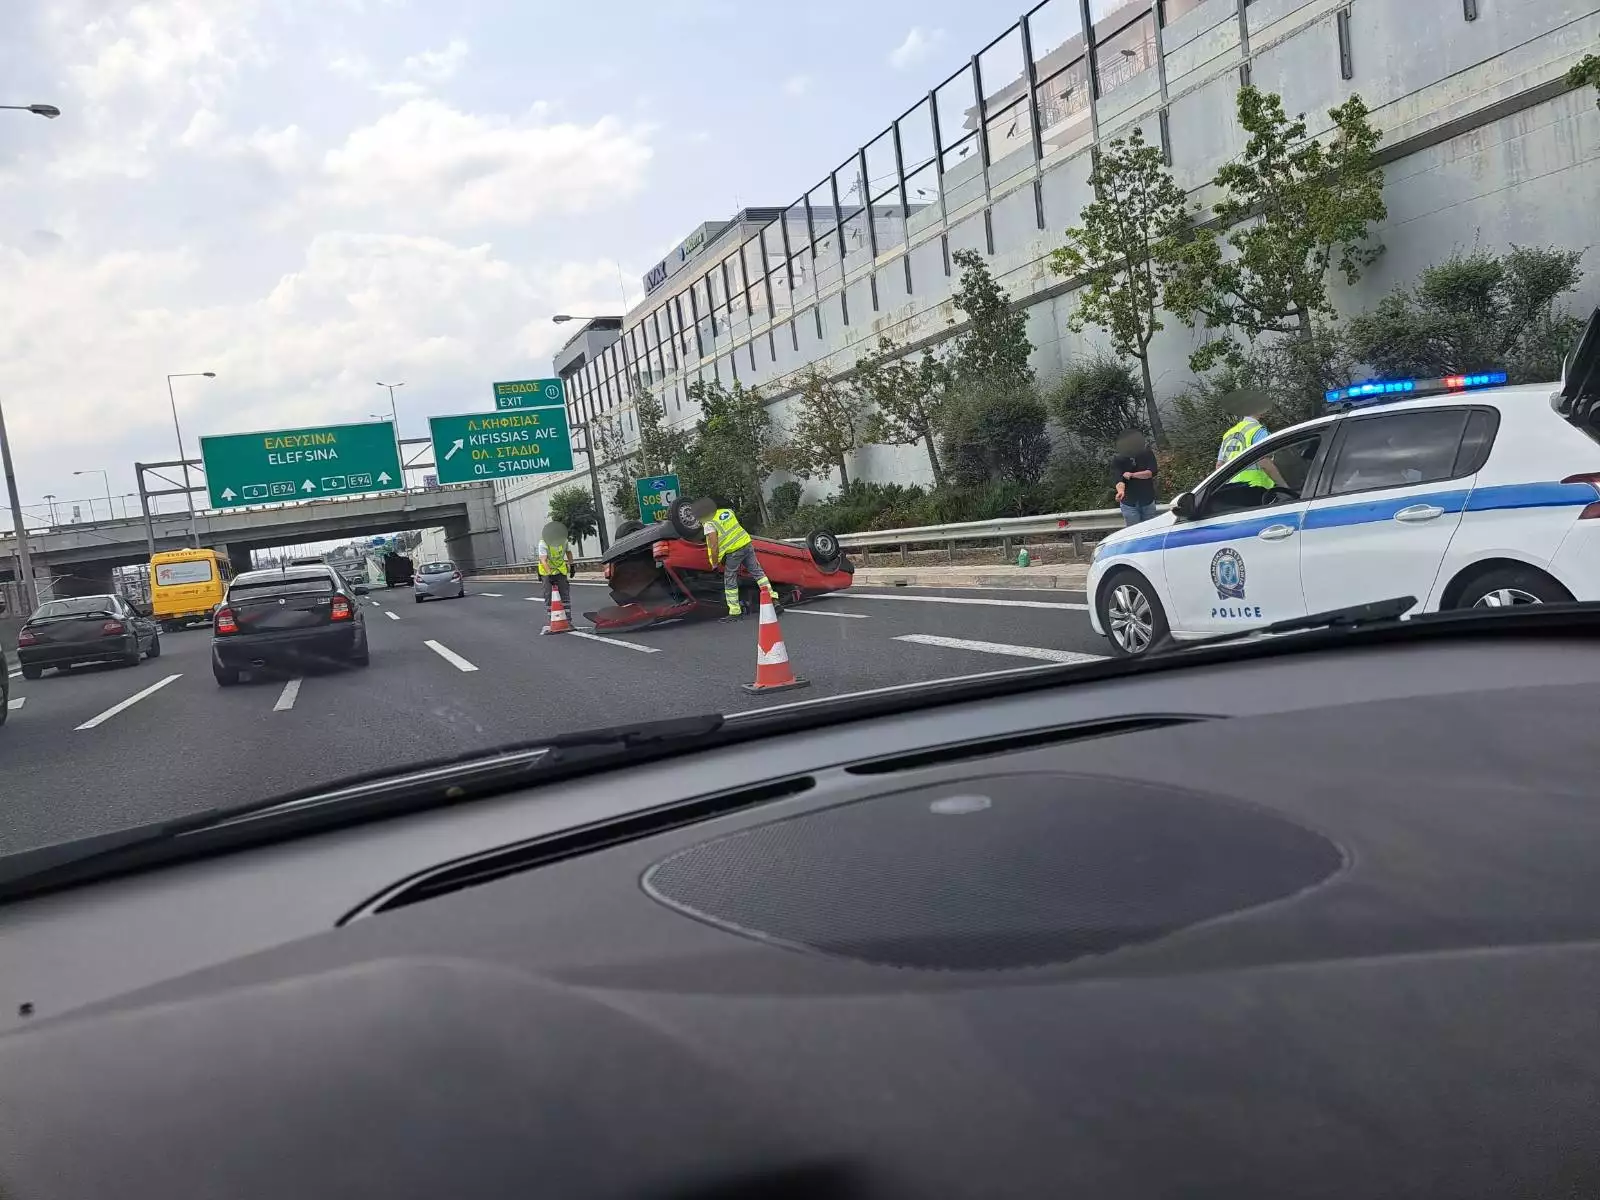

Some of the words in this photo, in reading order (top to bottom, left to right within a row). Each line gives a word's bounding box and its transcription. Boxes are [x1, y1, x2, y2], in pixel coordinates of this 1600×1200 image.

[498, 382, 540, 395] ΕΞΟΔΟΣ
[499, 396, 522, 408] EXIT
[482, 414, 540, 430] ΚΗΦΙΣΙΑΣ
[264, 433, 337, 450] ΕΛΕΥΣΙΝΑ
[469, 430, 529, 446] KIFISSIAS
[268, 448, 338, 465] ELEFSINA
[496, 443, 540, 459] ΣΤΑΔΙΟ
[498, 456, 551, 473] STADIUM
[350, 474, 370, 486] E94
[273, 482, 294, 494] E94
[642, 493, 663, 506] SOS
[1211, 606, 1262, 618] POLICE
